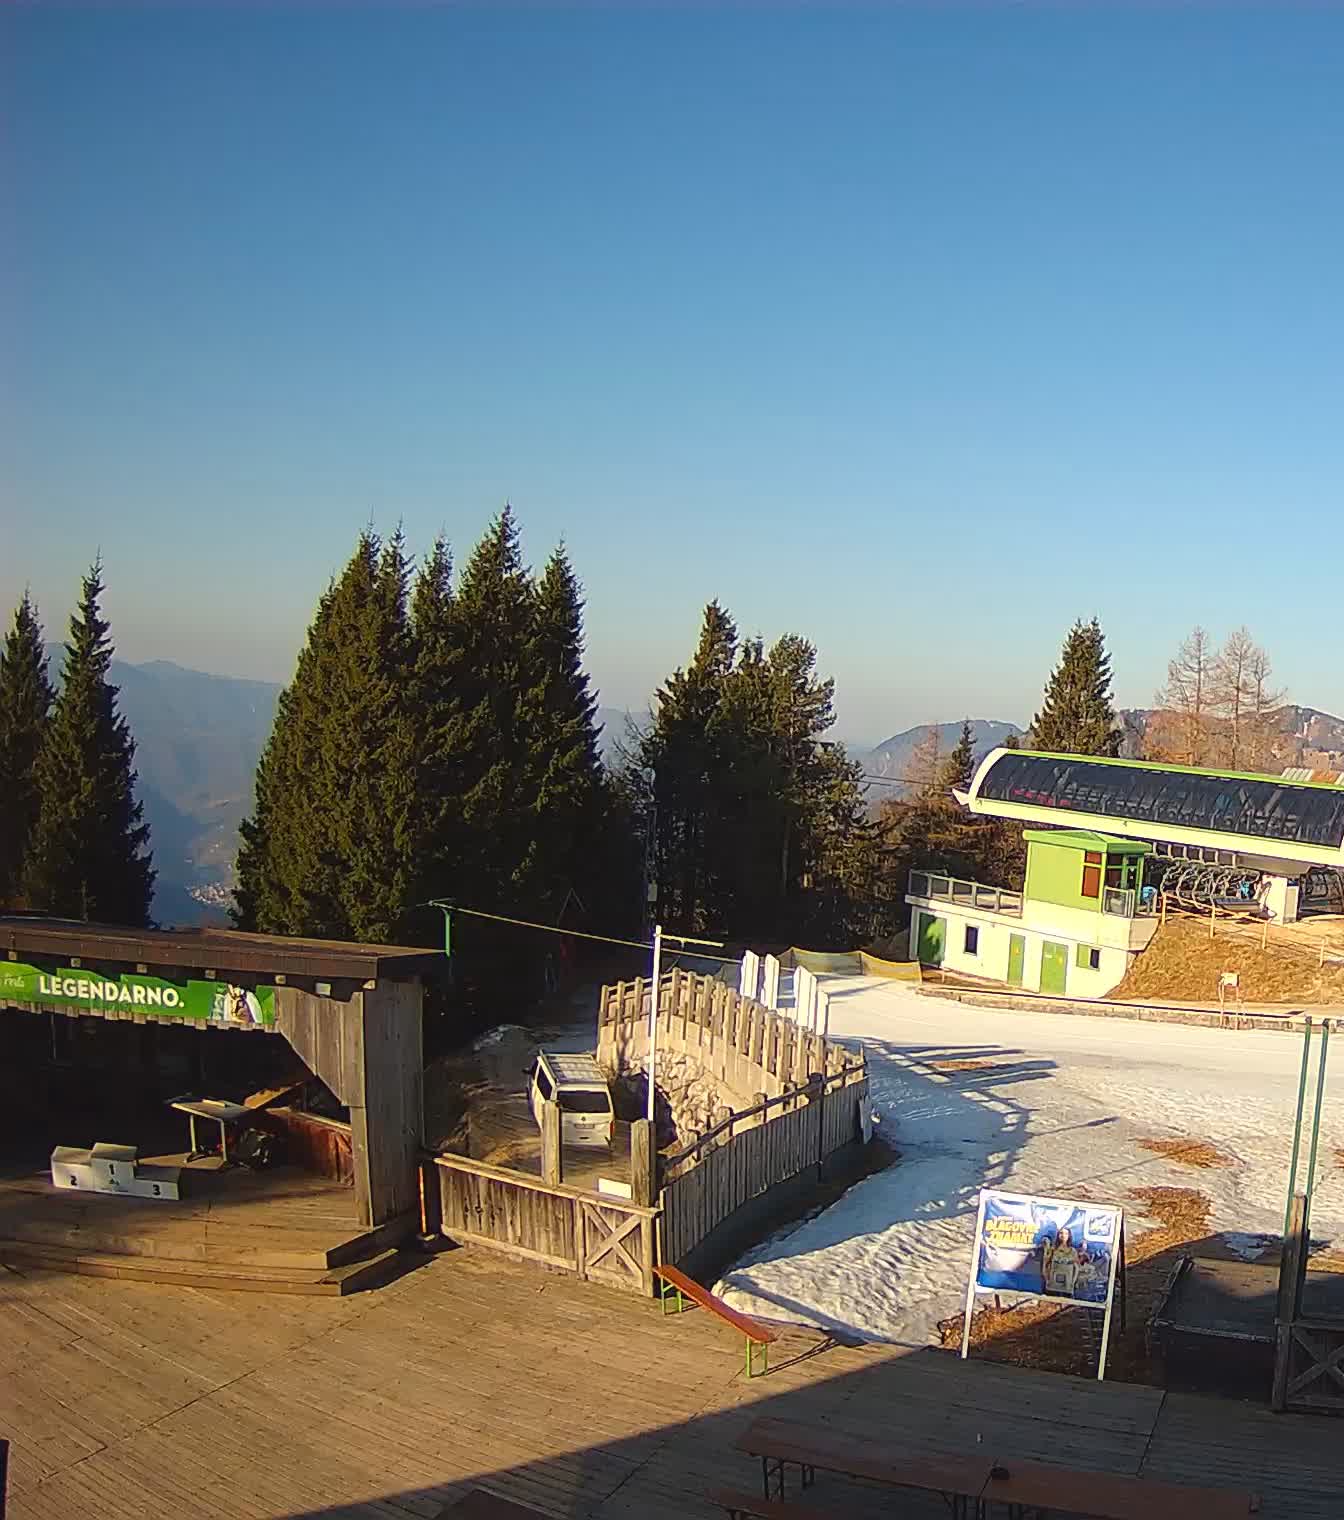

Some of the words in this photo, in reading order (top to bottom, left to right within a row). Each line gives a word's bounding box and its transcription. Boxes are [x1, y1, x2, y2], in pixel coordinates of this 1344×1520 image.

[39, 975, 185, 1008] LEGENDARNO.
[108, 1164, 115, 1175] 1
[70, 1175, 77, 1186] 2
[152, 1184, 161, 1196] 3
